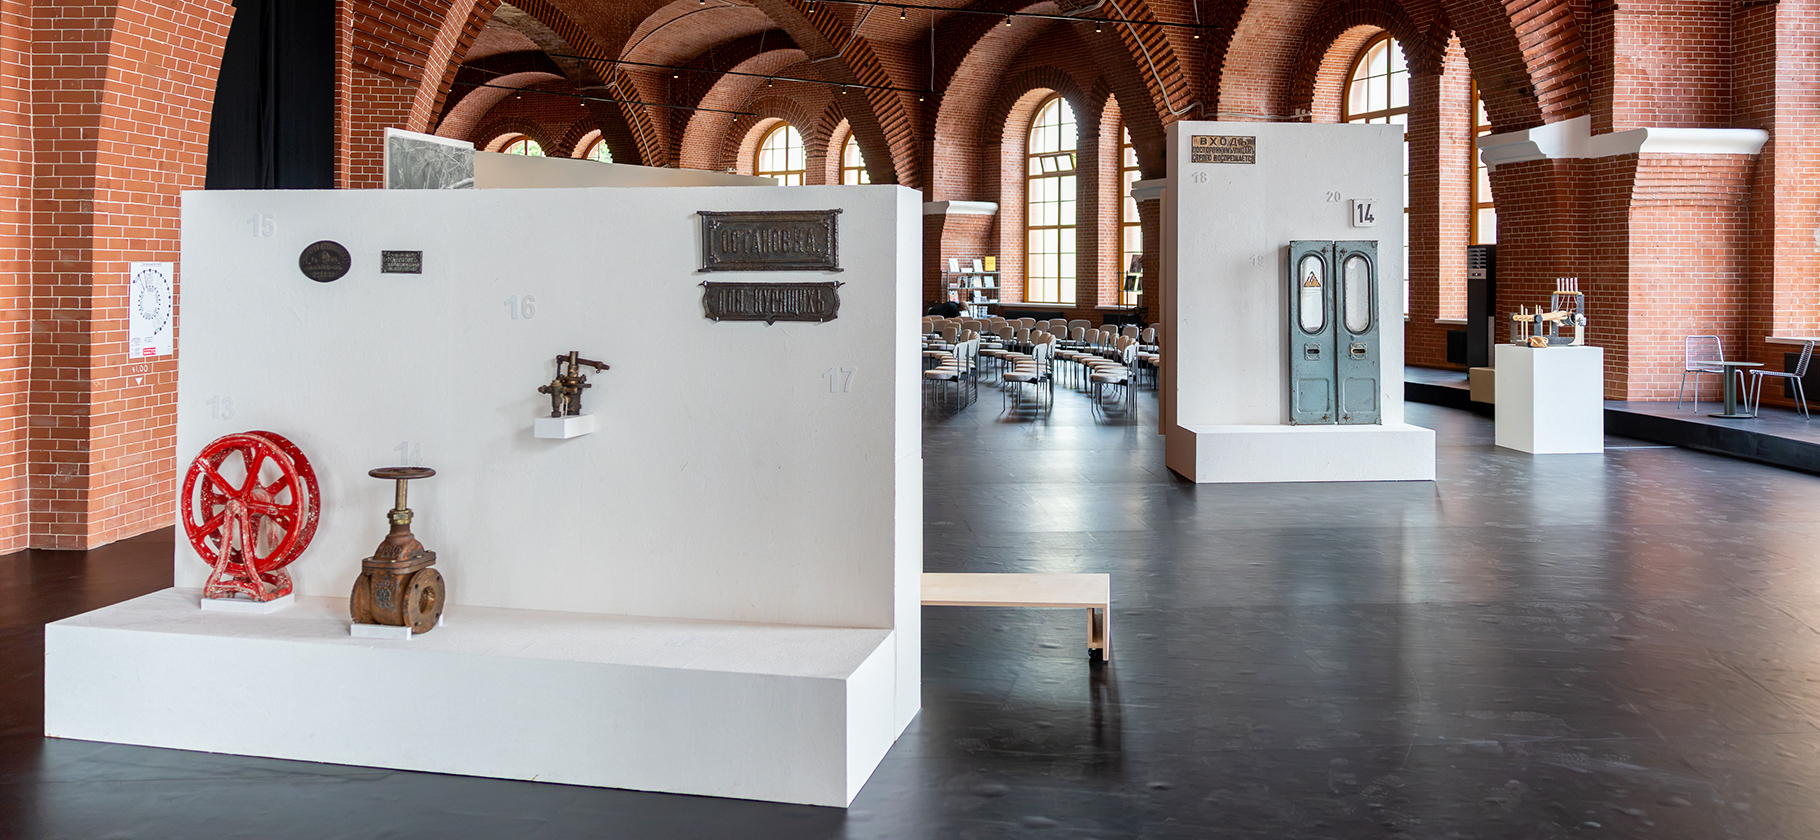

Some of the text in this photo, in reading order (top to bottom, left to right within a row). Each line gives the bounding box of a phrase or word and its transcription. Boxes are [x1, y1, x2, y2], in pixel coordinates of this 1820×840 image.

[1200, 137, 1248, 146] ВХОДЪ
[1191, 171, 1207, 183] 18
[1326, 191, 1341, 202] 20
[246, 213, 275, 238] 15
[1357, 203, 1375, 223] 14
[503, 294, 536, 320] 16
[821, 366, 858, 394] 17
[206, 395, 235, 420] 13
[394, 441, 423, 466] 14
